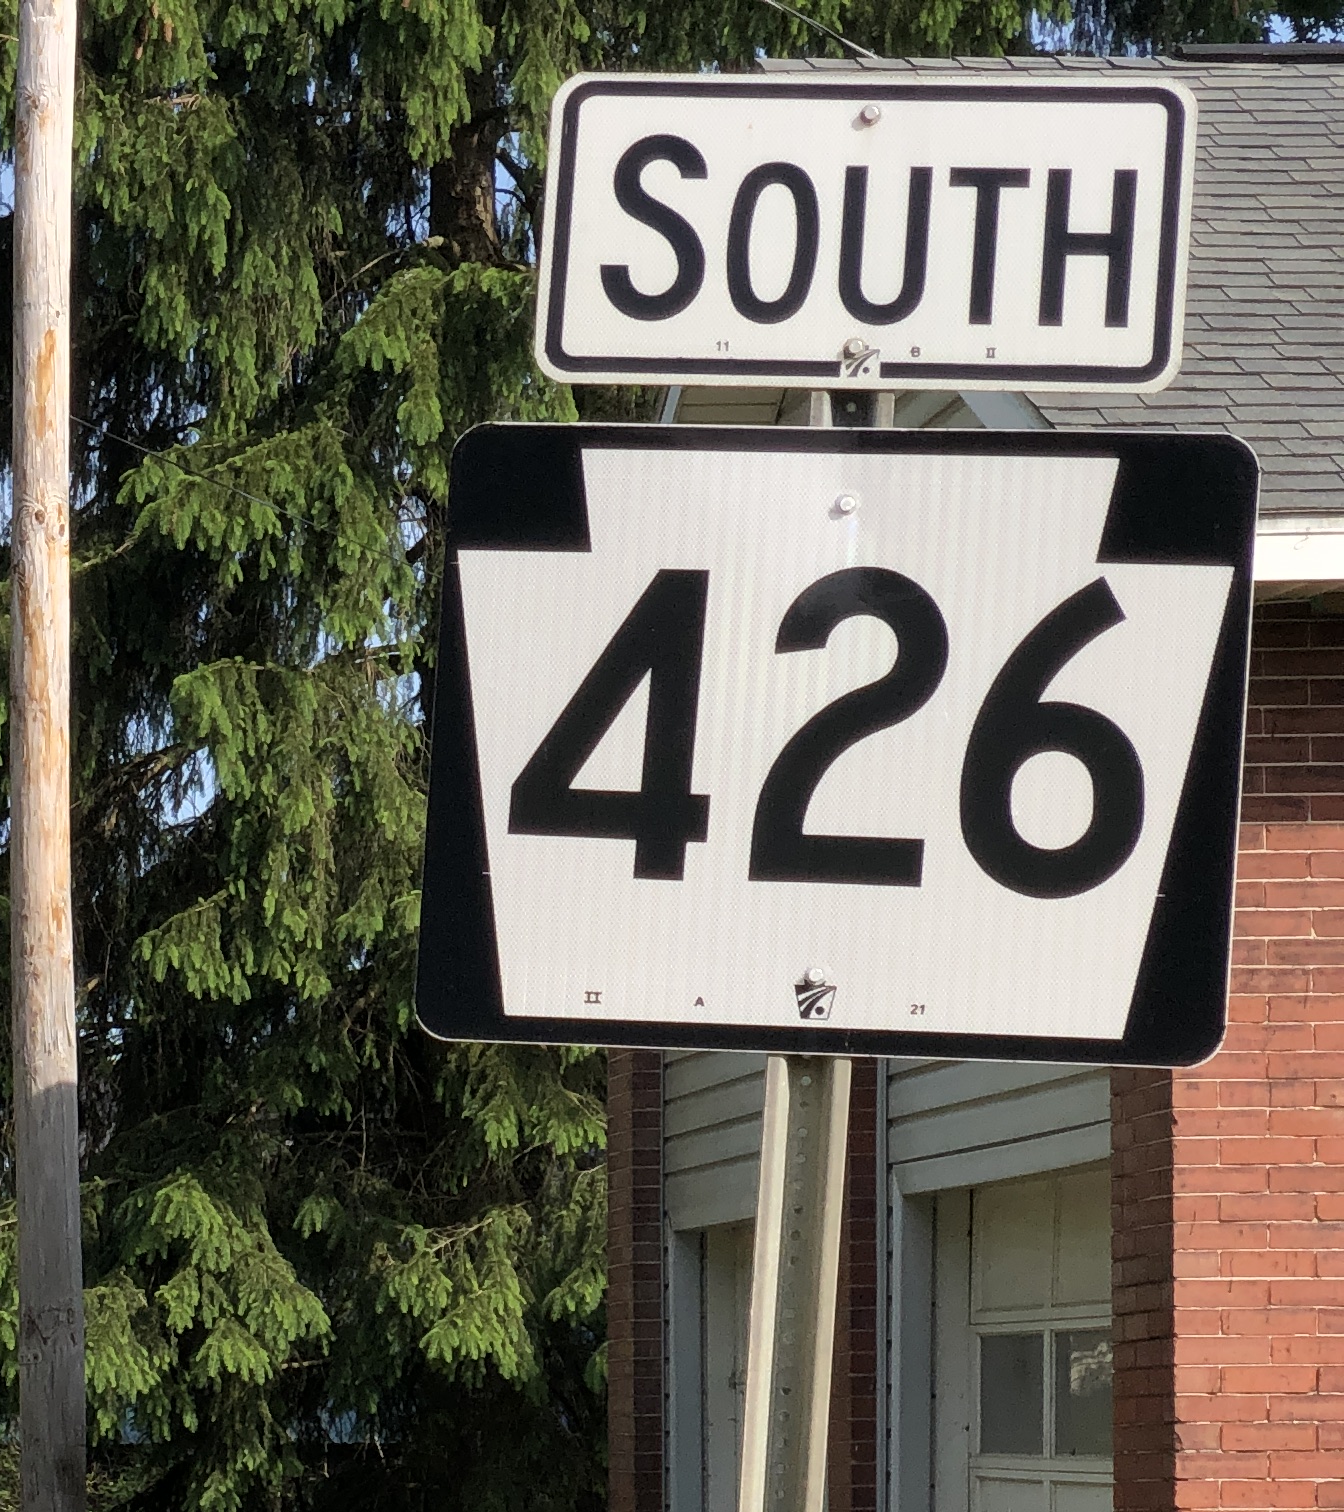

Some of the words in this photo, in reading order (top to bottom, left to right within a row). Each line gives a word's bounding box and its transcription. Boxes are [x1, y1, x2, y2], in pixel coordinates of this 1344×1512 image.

[599, 133, 1139, 329] SOUTH
[506, 566, 1146, 900] 426
[910, 1004, 925, 1015] 21
